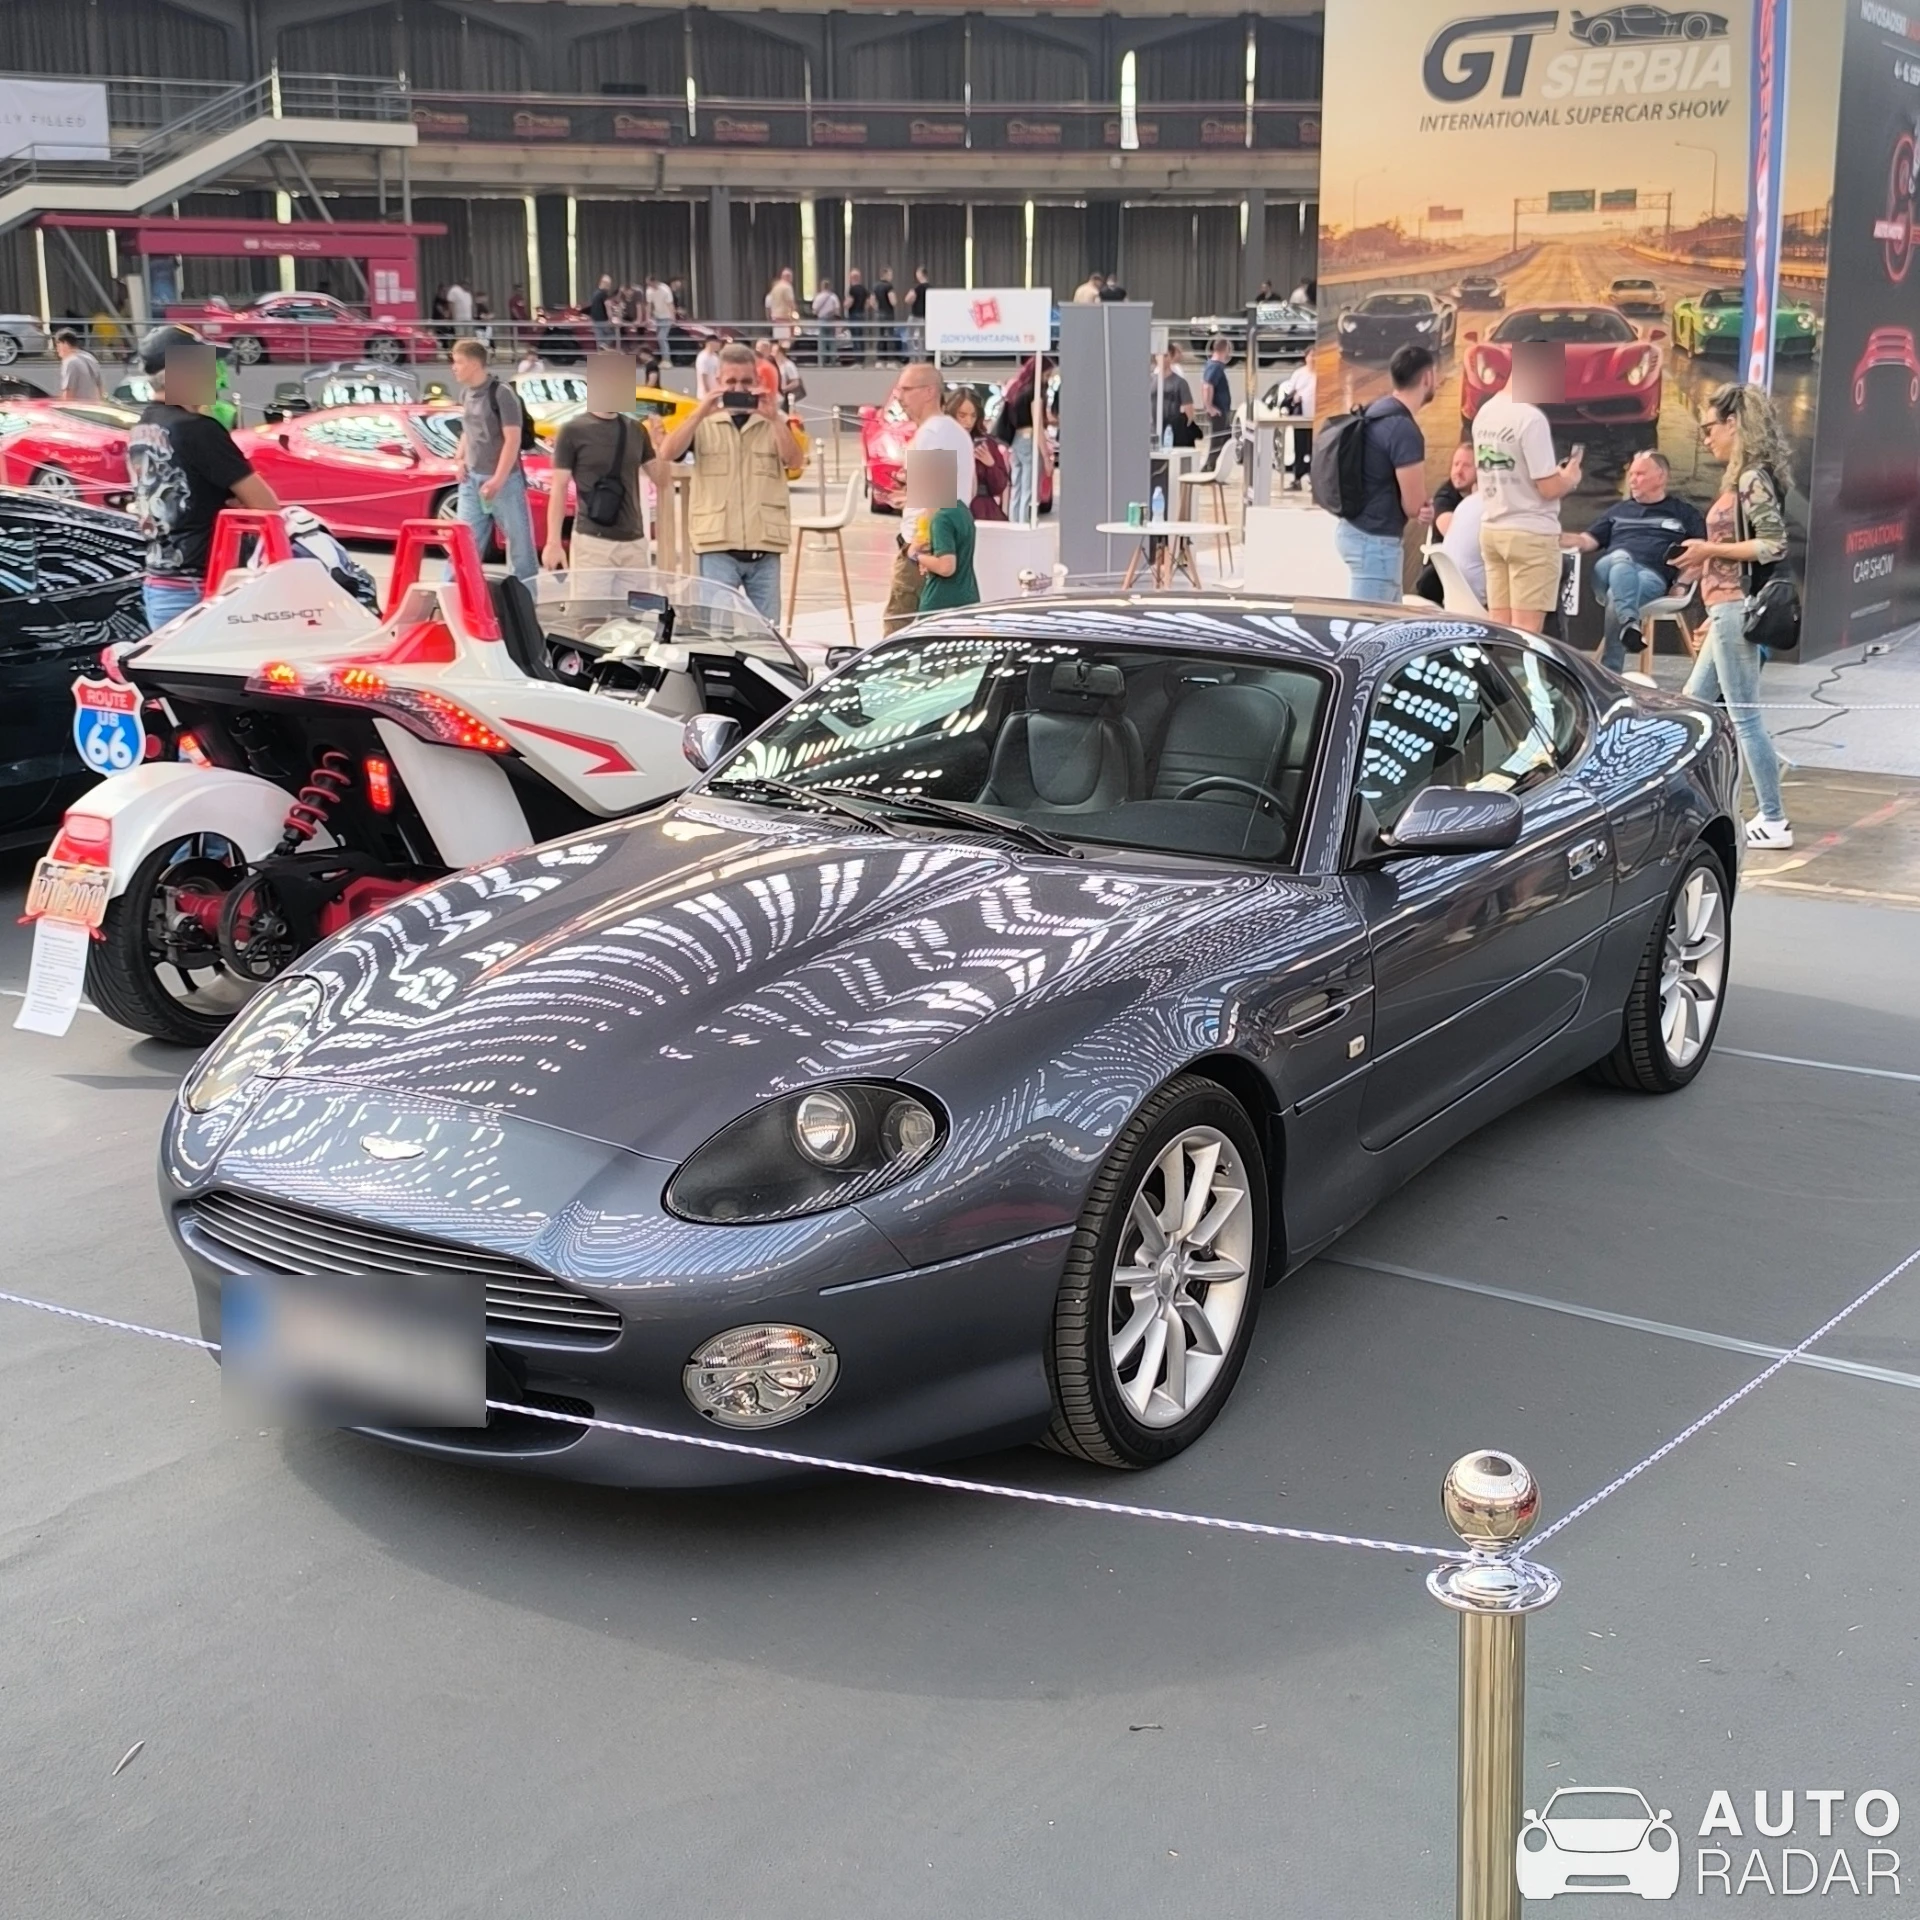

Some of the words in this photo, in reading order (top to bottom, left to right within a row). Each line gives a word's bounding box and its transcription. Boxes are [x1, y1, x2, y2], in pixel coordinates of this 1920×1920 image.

[1422, 10, 1560, 103] GT
[1540, 44, 1731, 99] SERBIA
[1419, 107, 1561, 132] INTERNATIONAL
[1564, 101, 1662, 126] SUPERCAR
[1666, 98, 1731, 120] SHOW
[1845, 522, 1904, 555] INTERNATIONAL
[1853, 561, 1869, 583] CAR
[1870, 553, 1894, 579] SHOW
[227, 608, 325, 625] SLINGSHOT
[86, 689, 129, 708] ROUTE
[96, 711, 120, 728] US
[86, 723, 133, 769] 66
